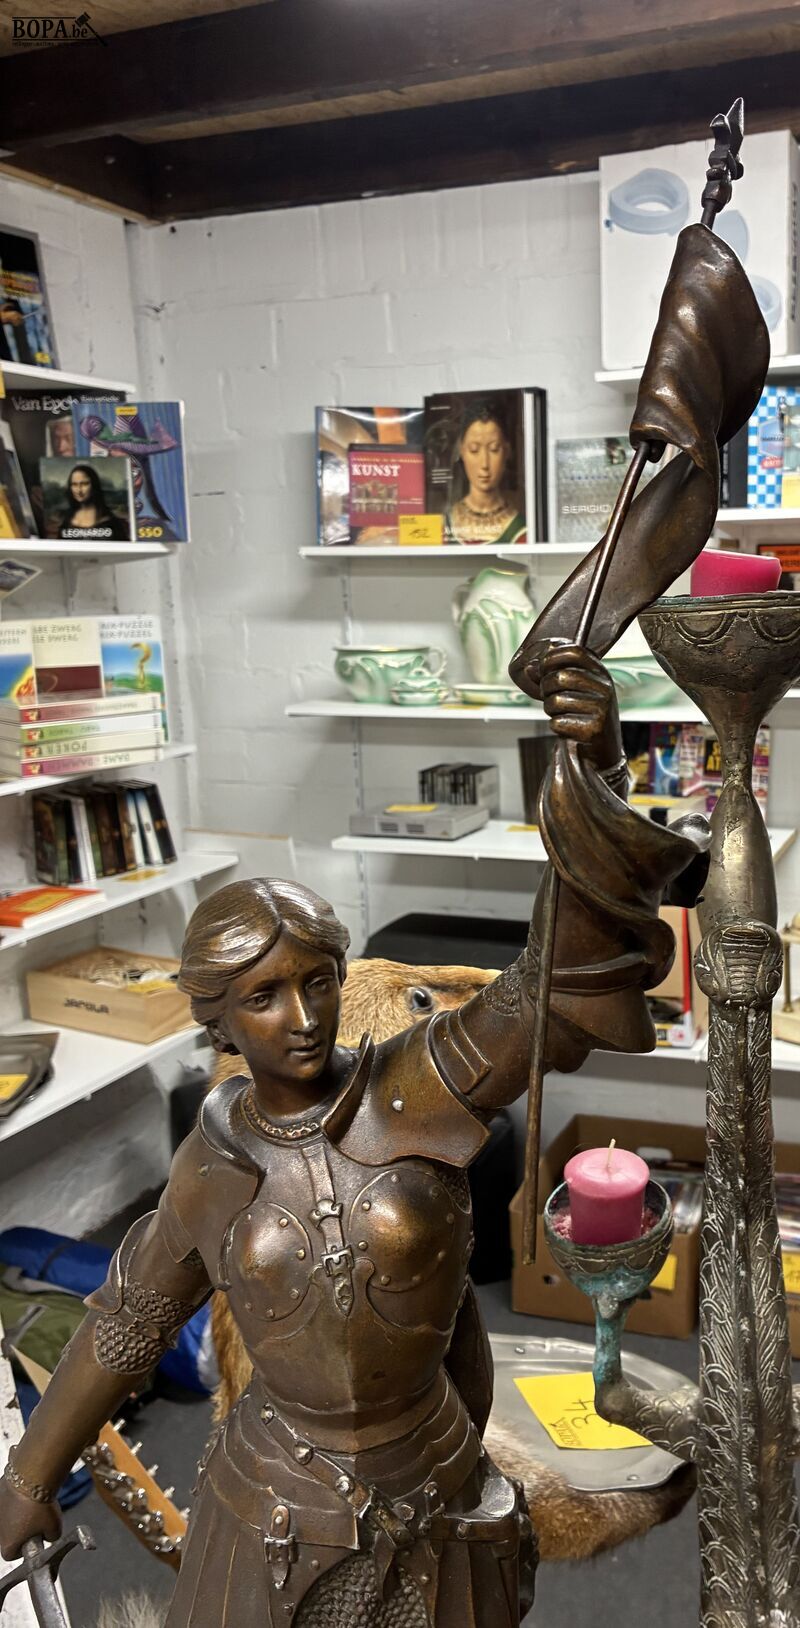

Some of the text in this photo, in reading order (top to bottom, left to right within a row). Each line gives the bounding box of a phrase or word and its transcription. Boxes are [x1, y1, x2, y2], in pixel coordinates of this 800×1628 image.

[12, 395, 41, 411] Van
[351, 463, 401, 478] KUNST
[561, 503, 611, 515] SERGIO
[62, 527, 113, 539] LEONARDO
